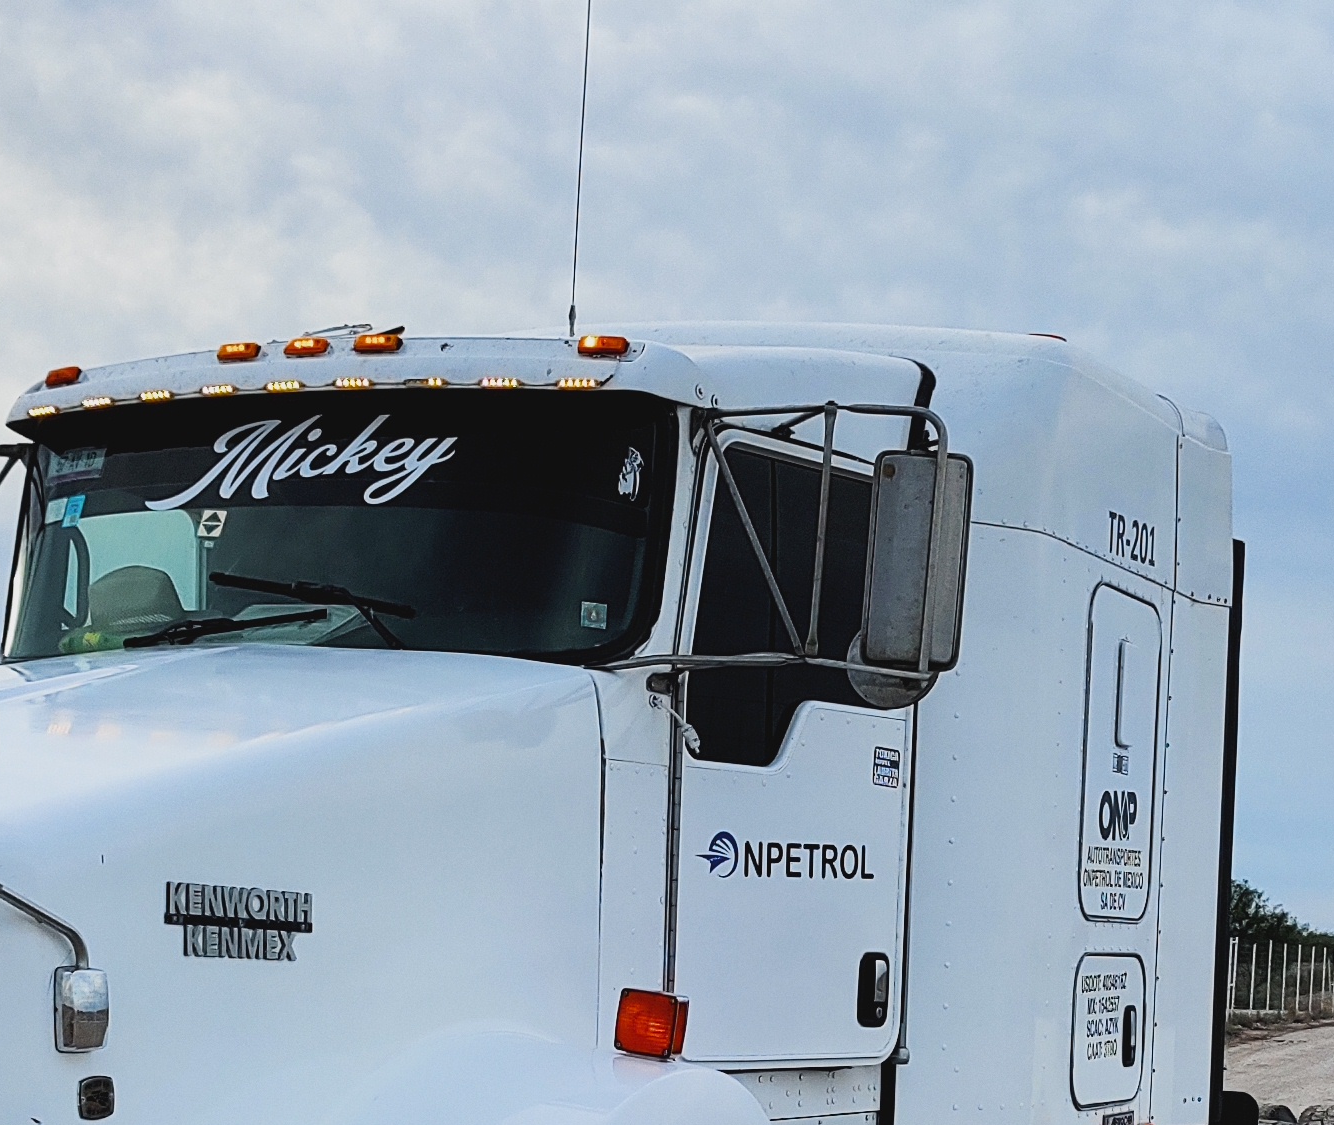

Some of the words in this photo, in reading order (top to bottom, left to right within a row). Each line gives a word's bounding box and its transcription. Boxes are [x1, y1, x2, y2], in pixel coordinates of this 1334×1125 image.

[145, 414, 456, 510] Mickey
[1108, 511, 1156, 567] TR-201
[1098, 790, 1138, 841] ONP
[1083, 868, 1113, 888] ONPETROL
[1114, 870, 1122, 888] DE
[1087, 846, 1142, 868] AUTOTRANSPORTES
[166, 881, 313, 924] KENWORTH
[183, 925, 298, 962] KENMEX
